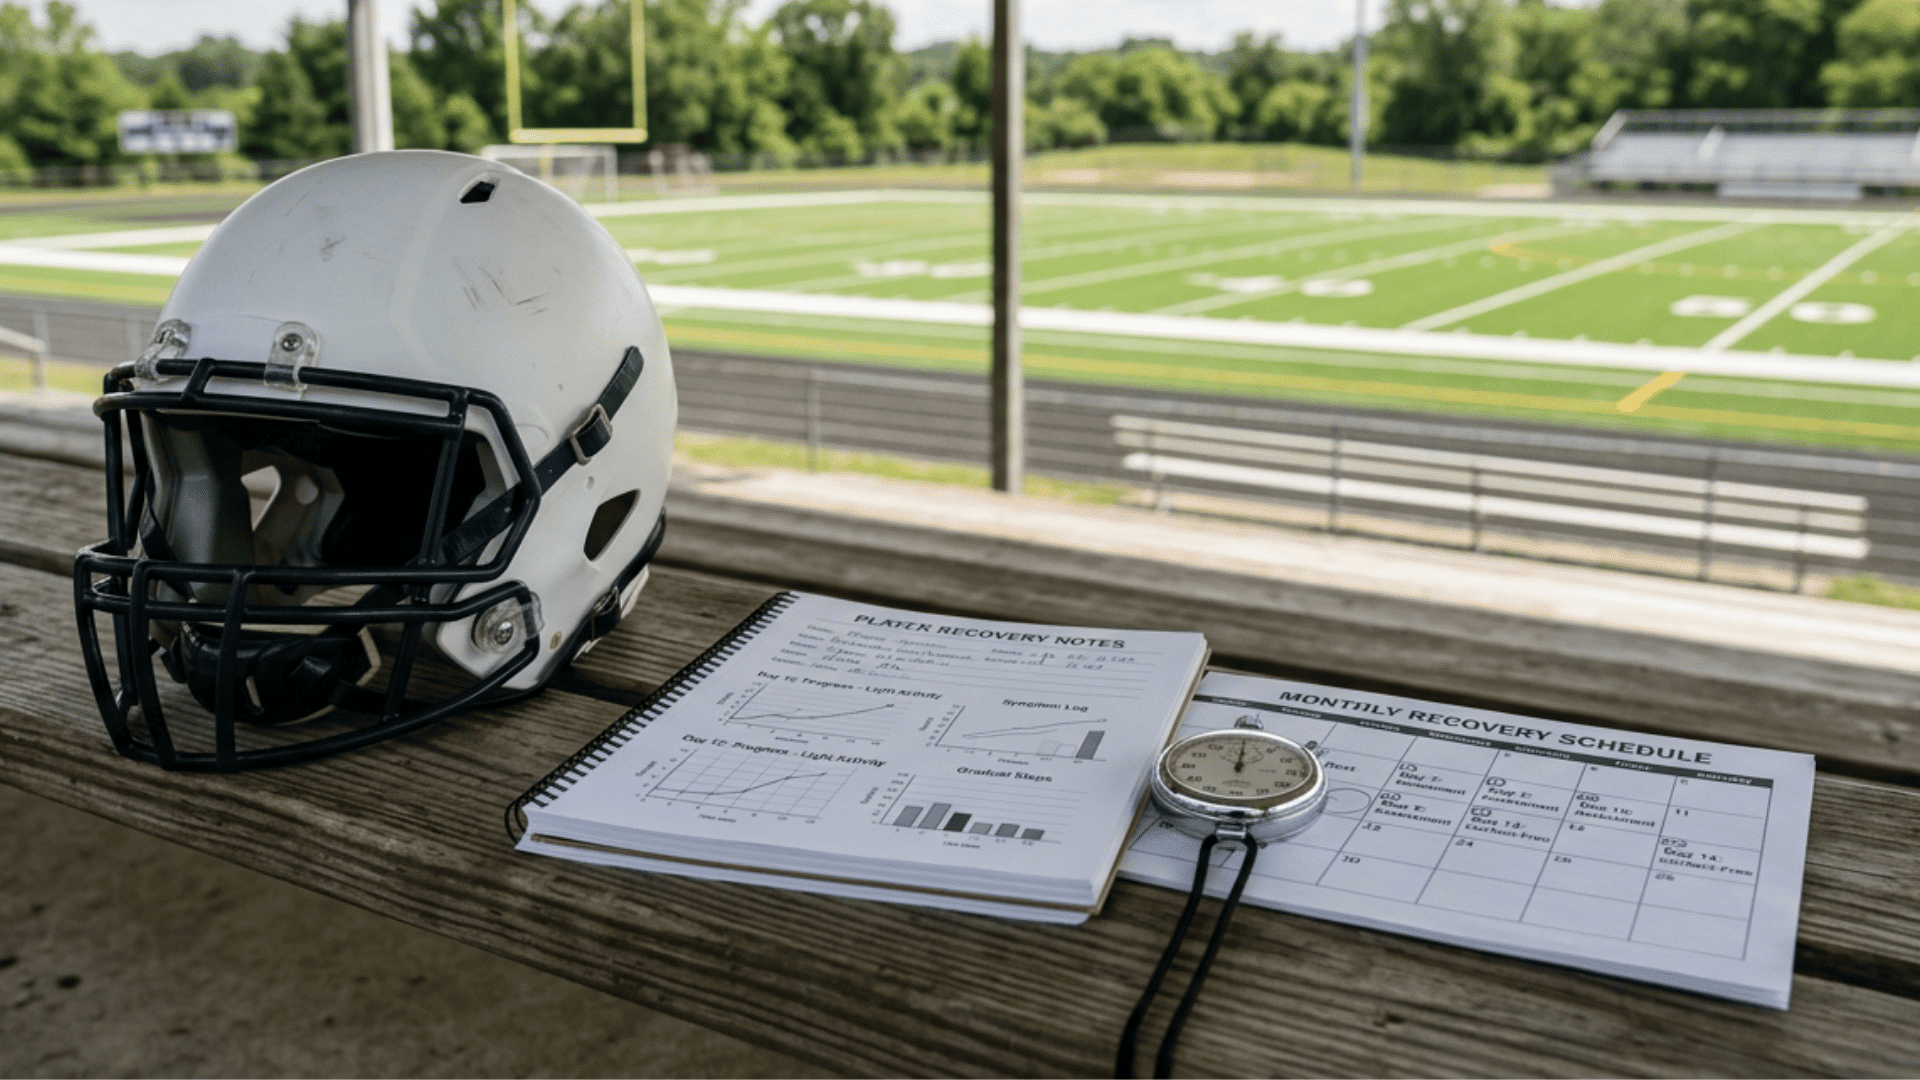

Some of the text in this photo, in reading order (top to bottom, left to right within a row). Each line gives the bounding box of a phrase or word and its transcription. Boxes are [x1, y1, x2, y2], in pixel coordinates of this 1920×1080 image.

[937, 625, 1049, 643] RECOVERY
[1054, 635, 1125, 649] NOTES
[1064, 702, 1090, 714] Log
[1279, 691, 1403, 717] MONTHLY
[1408, 709, 1552, 741] RECOVERY
[1558, 732, 1713, 764] SCHEDULE
